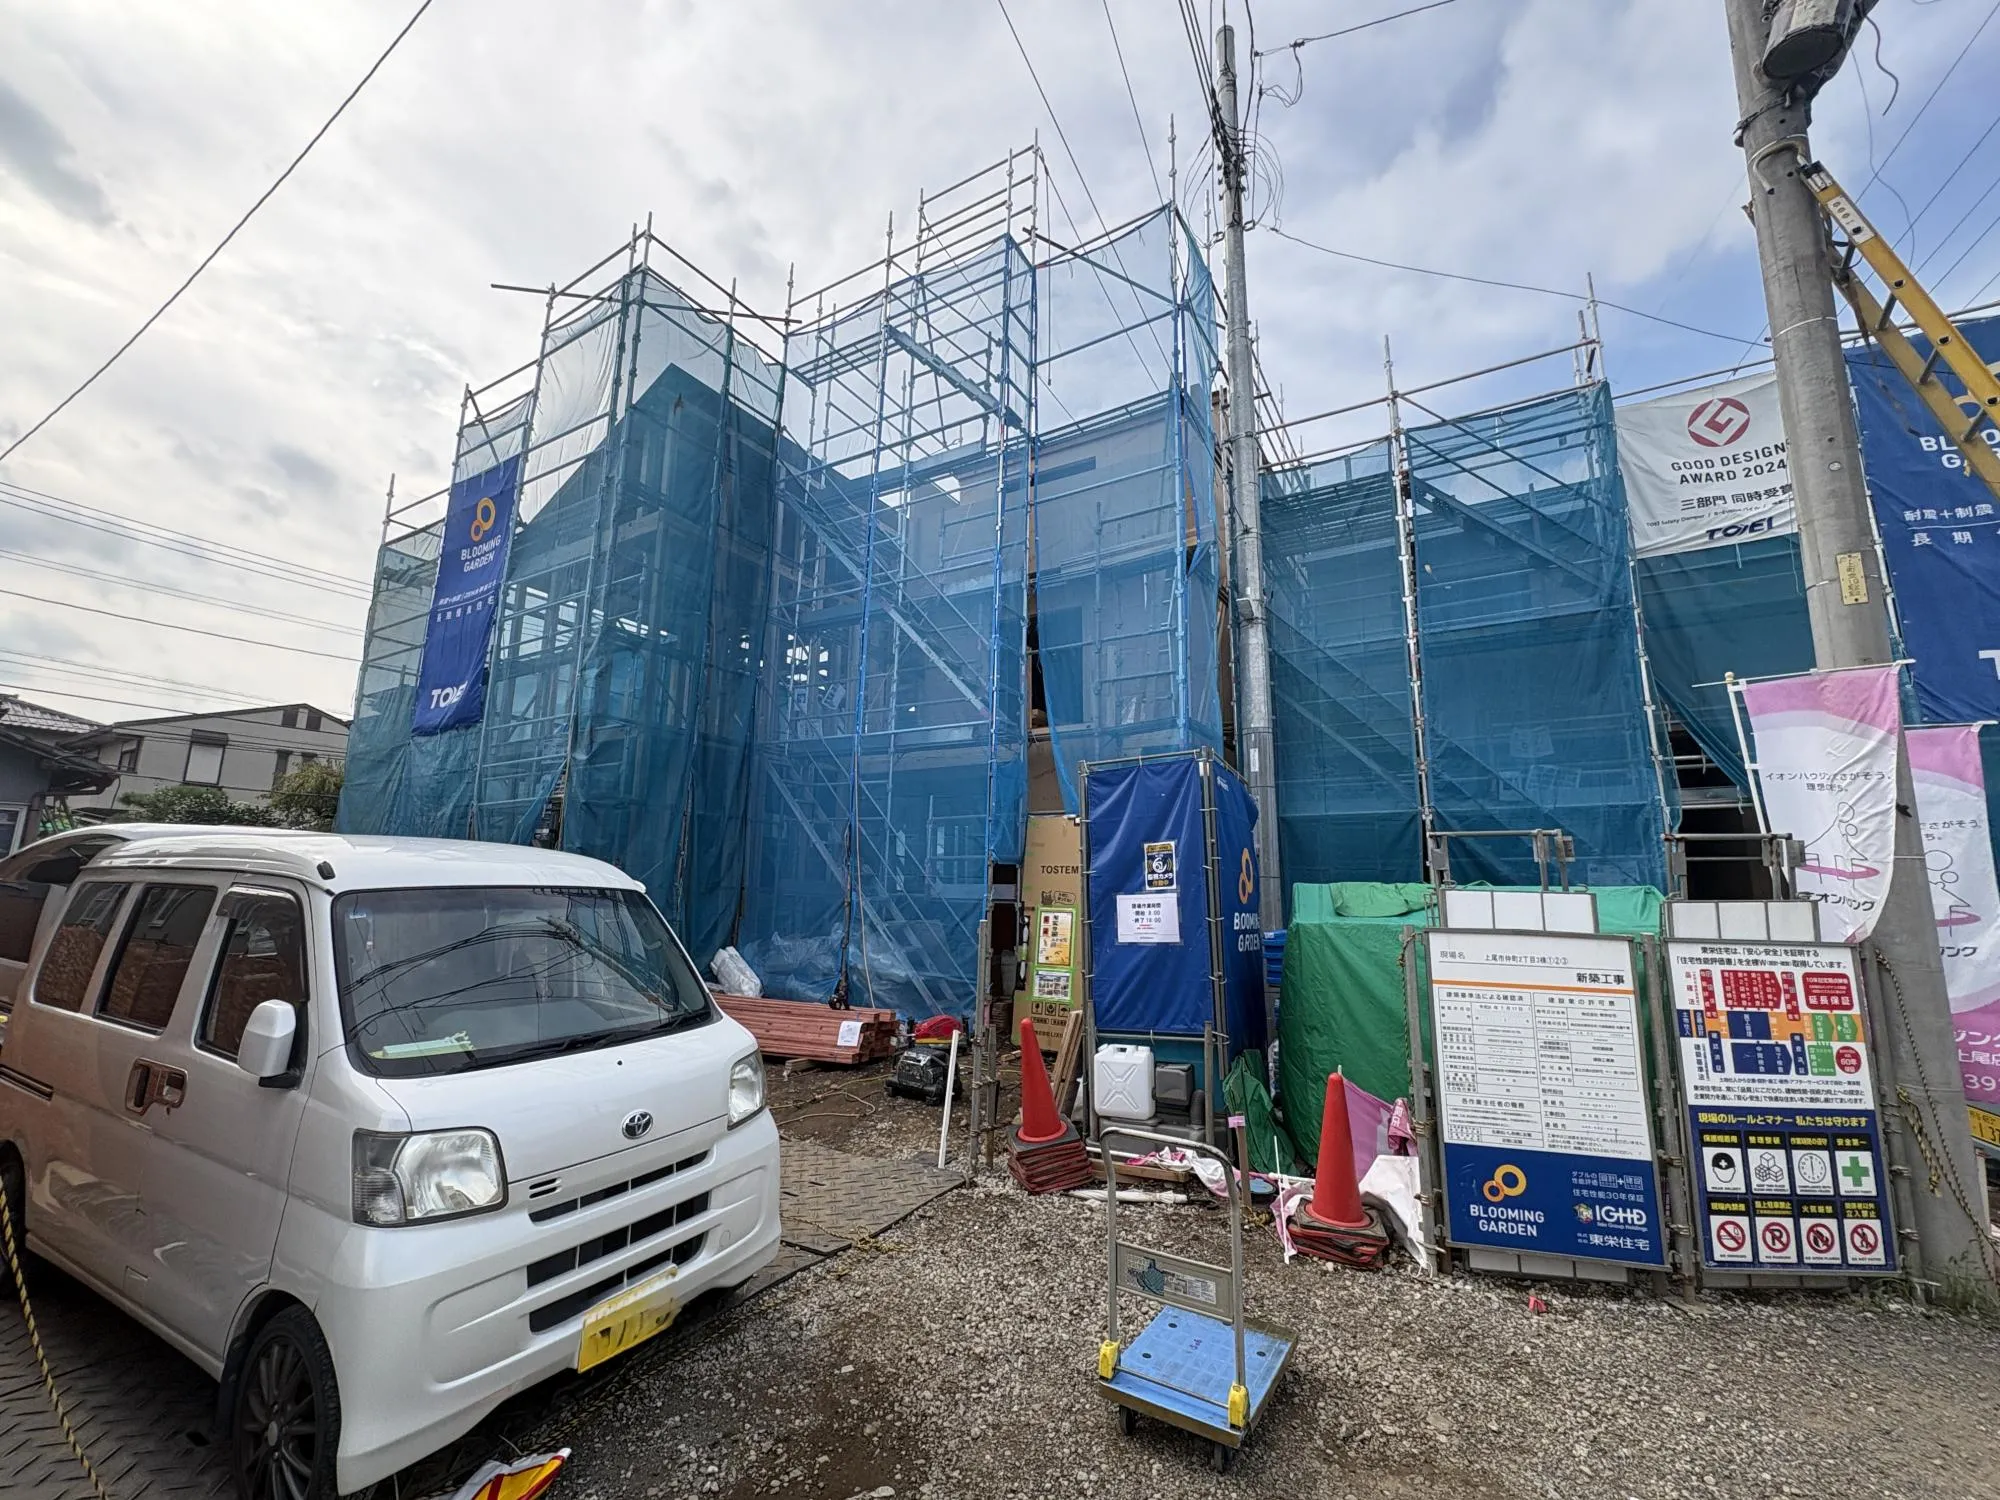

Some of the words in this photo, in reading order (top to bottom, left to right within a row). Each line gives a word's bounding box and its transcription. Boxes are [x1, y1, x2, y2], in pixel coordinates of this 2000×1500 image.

[1671, 458, 1715, 472] GOOD
[1720, 442, 1787, 467] DESIGN
[1680, 470, 1737, 485] AWARD
[1742, 459, 1787, 478] 2024
[1680, 495, 1728, 511] 三部門
[1706, 516, 1774, 541] TOEI
[460, 534, 502, 561] BLOOMING
[463, 551, 496, 573] GARDEN
[1040, 865, 1079, 875] TOSTEM
[1440, 950, 1466, 960] 現場名
[1576, 972, 1625, 985] 新築工事
[1964, 1074, 2000, 1091] 39
[1698, 1112, 1793, 1124] 現場のルールとマナー
[1796, 1115, 1868, 1127] 私たちは守ります
[1836, 1138, 1867, 1146] 安全第一
[1572, 1188, 1644, 1202] 住宅性能30年保証
[1470, 1204, 1545, 1223] BLOOMING
[1846, 1210, 1877, 1218] 立入禁止
[1479, 1219, 1538, 1237] GARDEN
[1589, 1233, 1650, 1251] 東栄住宅
